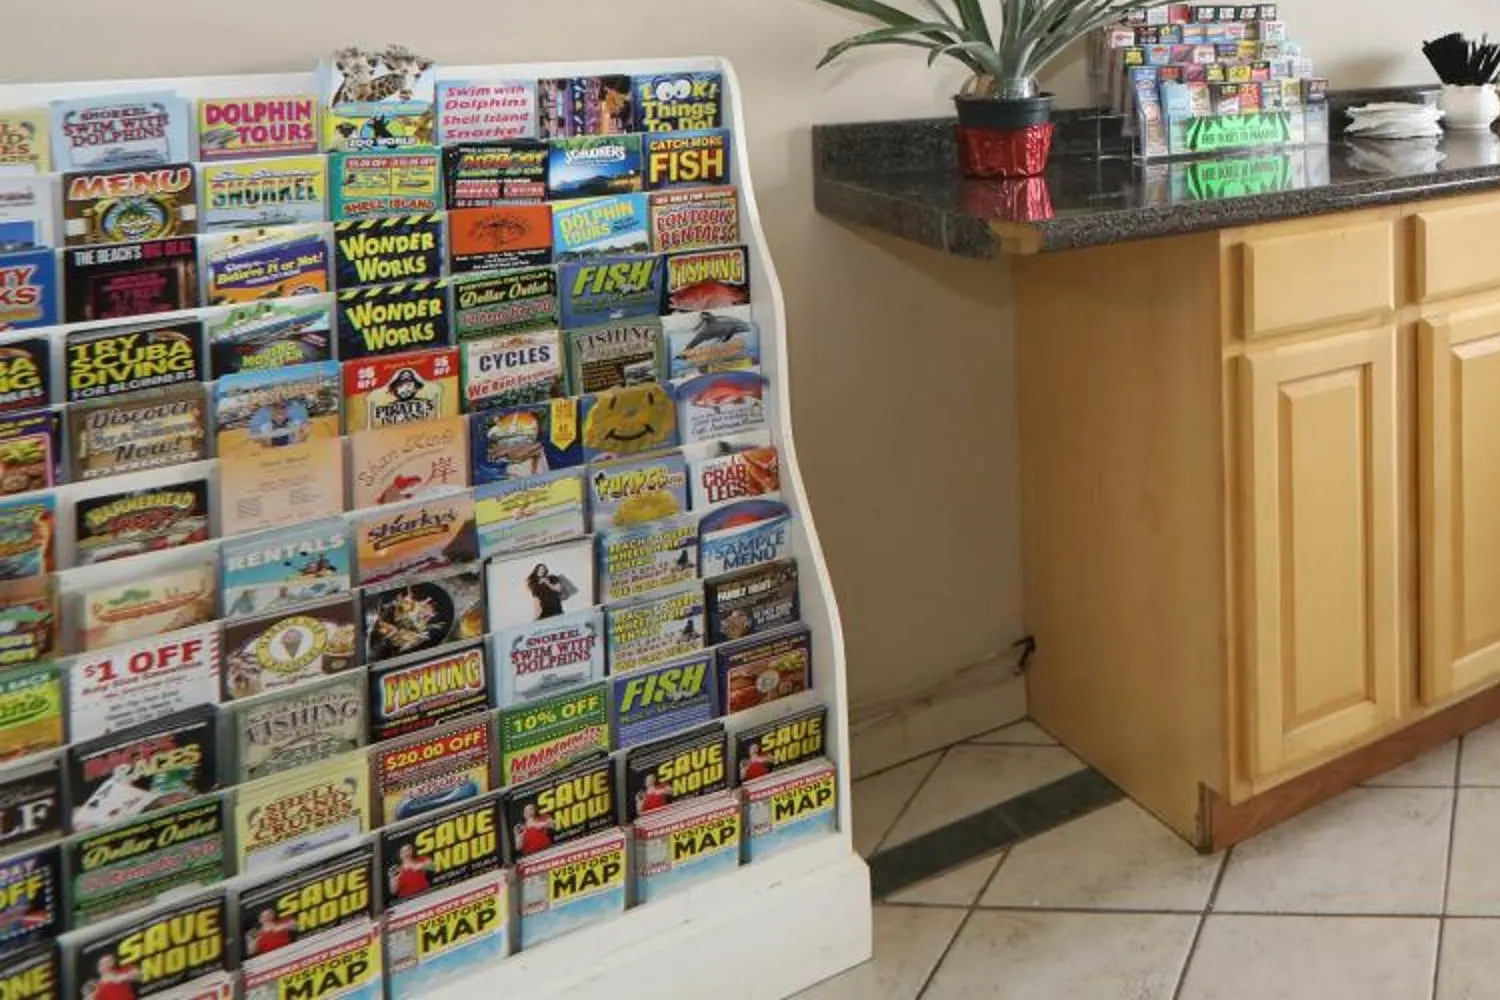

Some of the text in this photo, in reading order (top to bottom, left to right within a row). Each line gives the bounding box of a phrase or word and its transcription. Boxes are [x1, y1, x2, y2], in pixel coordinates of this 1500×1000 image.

[445, 98, 528, 111] Dolphins
[447, 85, 526, 97] Swim with
[63, 114, 171, 137] SWIM WITH
[205, 100, 312, 126] DOLPHIN
[443, 111, 530, 127] Shell Island
[642, 100, 718, 120] Things
[71, 127, 166, 149] DOLPHINS
[234, 122, 313, 145] TOURS
[446, 126, 528, 139] Snorkel
[649, 137, 724, 152] CATCH MORE
[649, 150, 724, 183] FISH
[69, 168, 193, 200] MENU
[562, 201, 634, 232] DOLPHIN
[339, 231, 436, 261] WONDER
[567, 223, 610, 247] TOURS
[75, 253, 97, 268] THE
[98, 247, 142, 265] BEACH'S
[355, 254, 427, 282] WORKS
[670, 252, 744, 285] FISHING
[572, 257, 654, 298] FISH
[460, 281, 549, 309] Dollar Outlet
[346, 298, 443, 331] WONDER
[69, 333, 140, 363] TRY
[362, 322, 435, 352] WORKS
[576, 325, 656, 352] FISHING
[69, 340, 192, 374] SCUBA
[69, 354, 194, 390] DIVING
[479, 345, 551, 372] CYCLES
[93, 401, 189, 430] Discover
[375, 399, 434, 419] PIRATE'S
[114, 436, 181, 462] Now!
[702, 463, 747, 489] CRAB
[704, 476, 747, 504] LEGS
[226, 534, 346, 572] RENTALS
[717, 529, 786, 561] SAMPLE
[723, 545, 777, 572] MENU
[129, 639, 203, 674] OFF
[511, 635, 596, 664] SWIM WITH
[517, 649, 592, 676] DOLPHINS
[382, 652, 482, 714] FISHING
[619, 661, 708, 714] FISH
[245, 701, 359, 745] FISHING
[513, 695, 600, 733] 10% OFF
[760, 717, 821, 749] SAVE
[385, 732, 482, 771] $20.00 OFF
[656, 741, 723, 783] SAVE
[774, 735, 821, 765] NOW
[535, 767, 609, 812] SAVE
[671, 762, 723, 800] NOW
[771, 779, 832, 802] VISITOR'S
[552, 787, 610, 831] NOW
[775, 787, 833, 822] MAP
[414, 814, 494, 857] SAVE
[672, 816, 737, 841] VISITOR'S
[673, 825, 737, 861] MAP
[433, 834, 497, 873] NOW
[550, 851, 621, 879] VISITOR'S
[276, 866, 368, 919] SAVE
[552, 863, 621, 899] MAP
[296, 888, 369, 933] NOW
[420, 898, 496, 930] VISITOR'S
[117, 906, 219, 967] SAVE
[422, 907, 498, 953] MAP
[140, 934, 220, 981] NOW
[283, 947, 369, 986] VISITOR'S
[284, 960, 369, 1000] MAP
